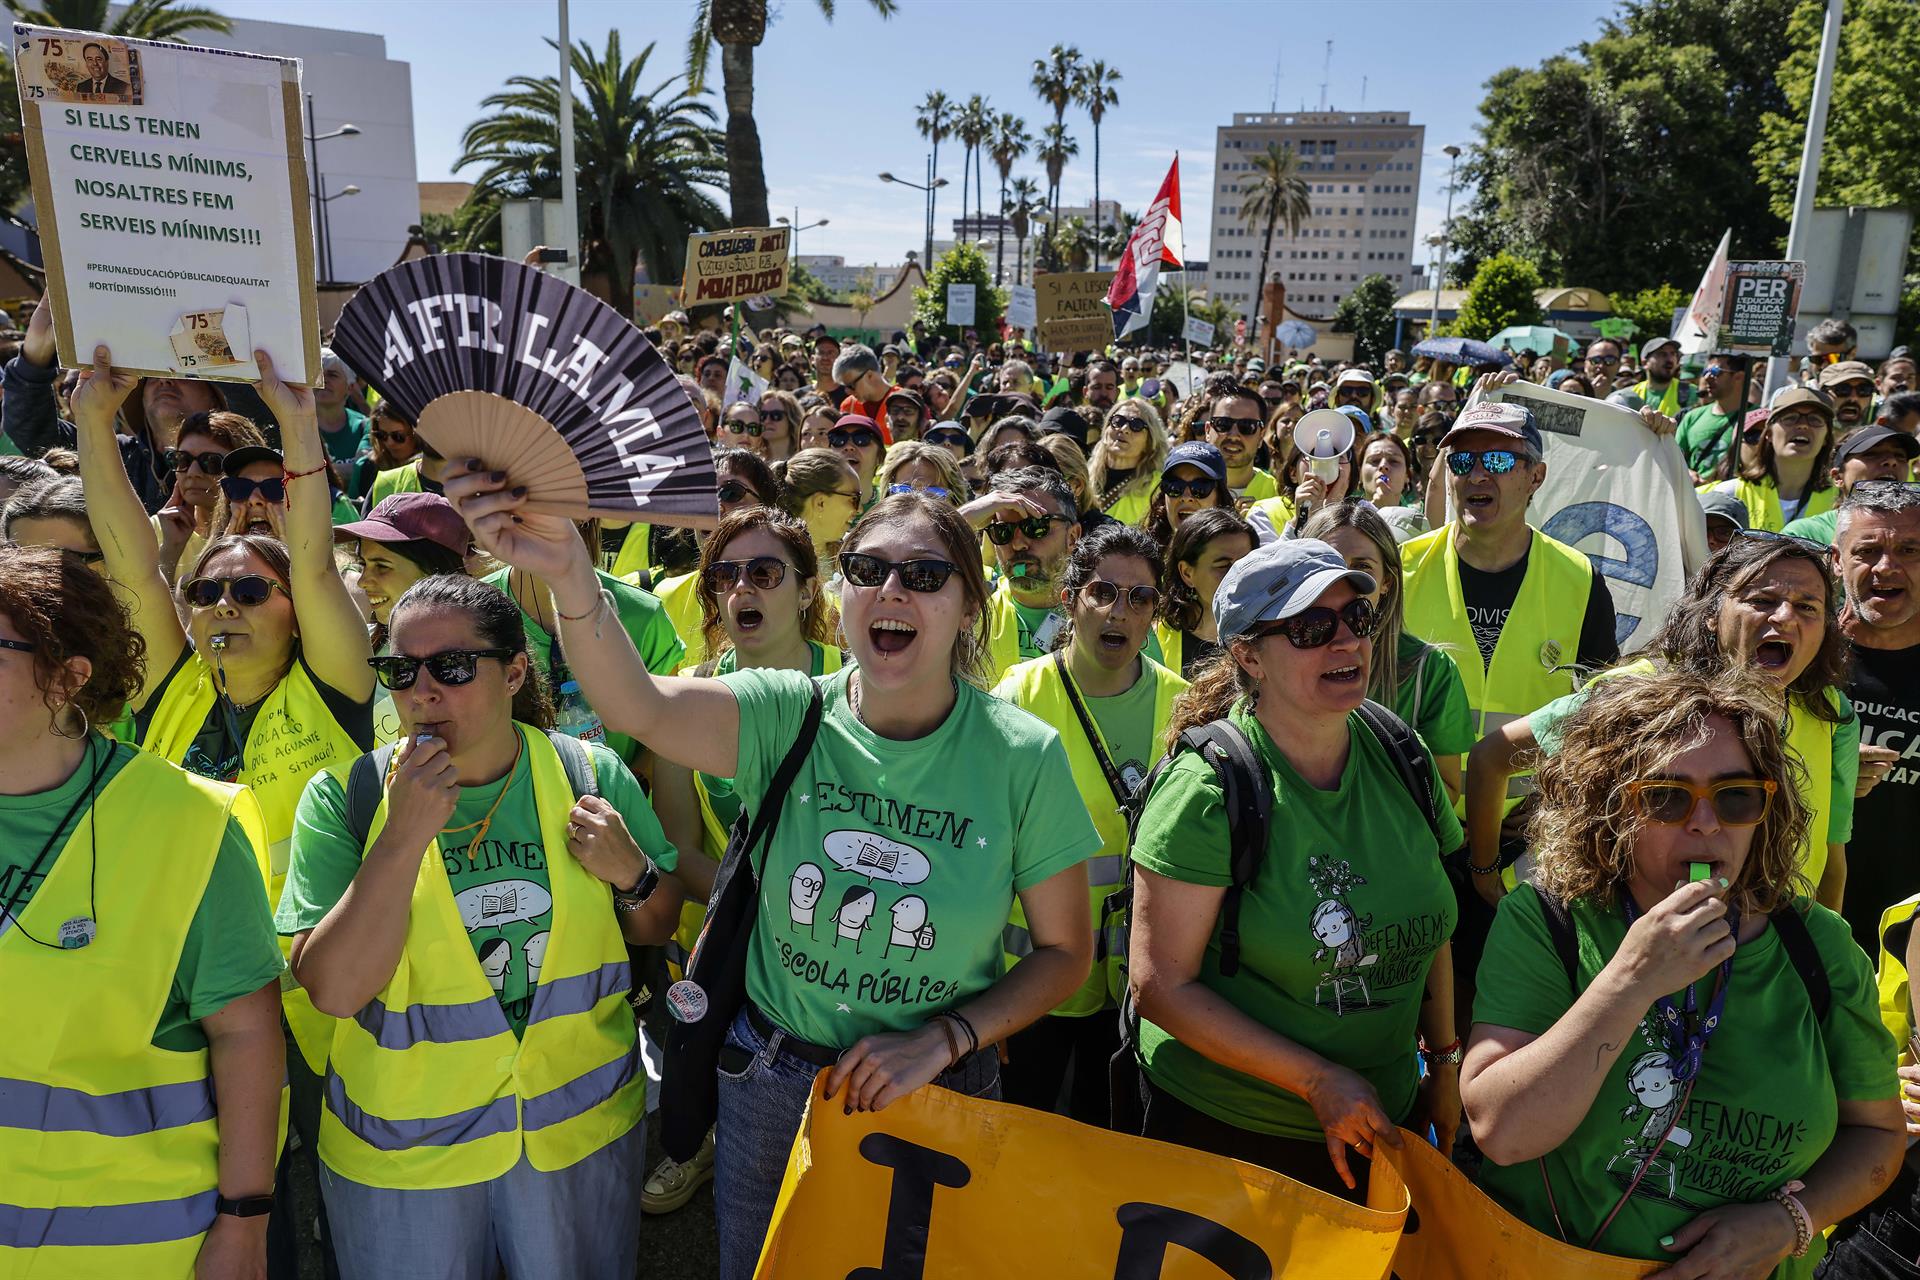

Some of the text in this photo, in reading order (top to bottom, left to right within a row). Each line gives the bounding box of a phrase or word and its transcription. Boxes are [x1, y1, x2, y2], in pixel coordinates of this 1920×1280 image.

[38, 38, 63, 56] 75
[28, 86, 45, 98] 75
[65, 108, 200, 139] SI ELLS TENEN
[70, 144, 253, 183] CERVELLS MÍNIMS,
[75, 178, 234, 210] NOSALTRES FEM
[80, 212, 261, 246] SERVEIS MÍNIMS!!!
[87, 262, 270, 288] #PERUNAEDUCACIÓPÚBLICAIDEQUALITAT
[88, 281, 177, 297] #ORTÍDIMISSIÓ!!!!
[1738, 278, 1788, 297] PER
[186, 313, 208, 329] 75
[181, 355, 196, 366] 75
[1849, 700, 1920, 725] DUCAC
[275, 731, 321, 759] AGUANTE
[251, 772, 278, 791] ESTA
[816, 782, 974, 849] ESTIMEM
[775, 937, 850, 994] SCOLA
[631, 992, 652, 1008] adidas
[692, 989, 703, 1000] JO
